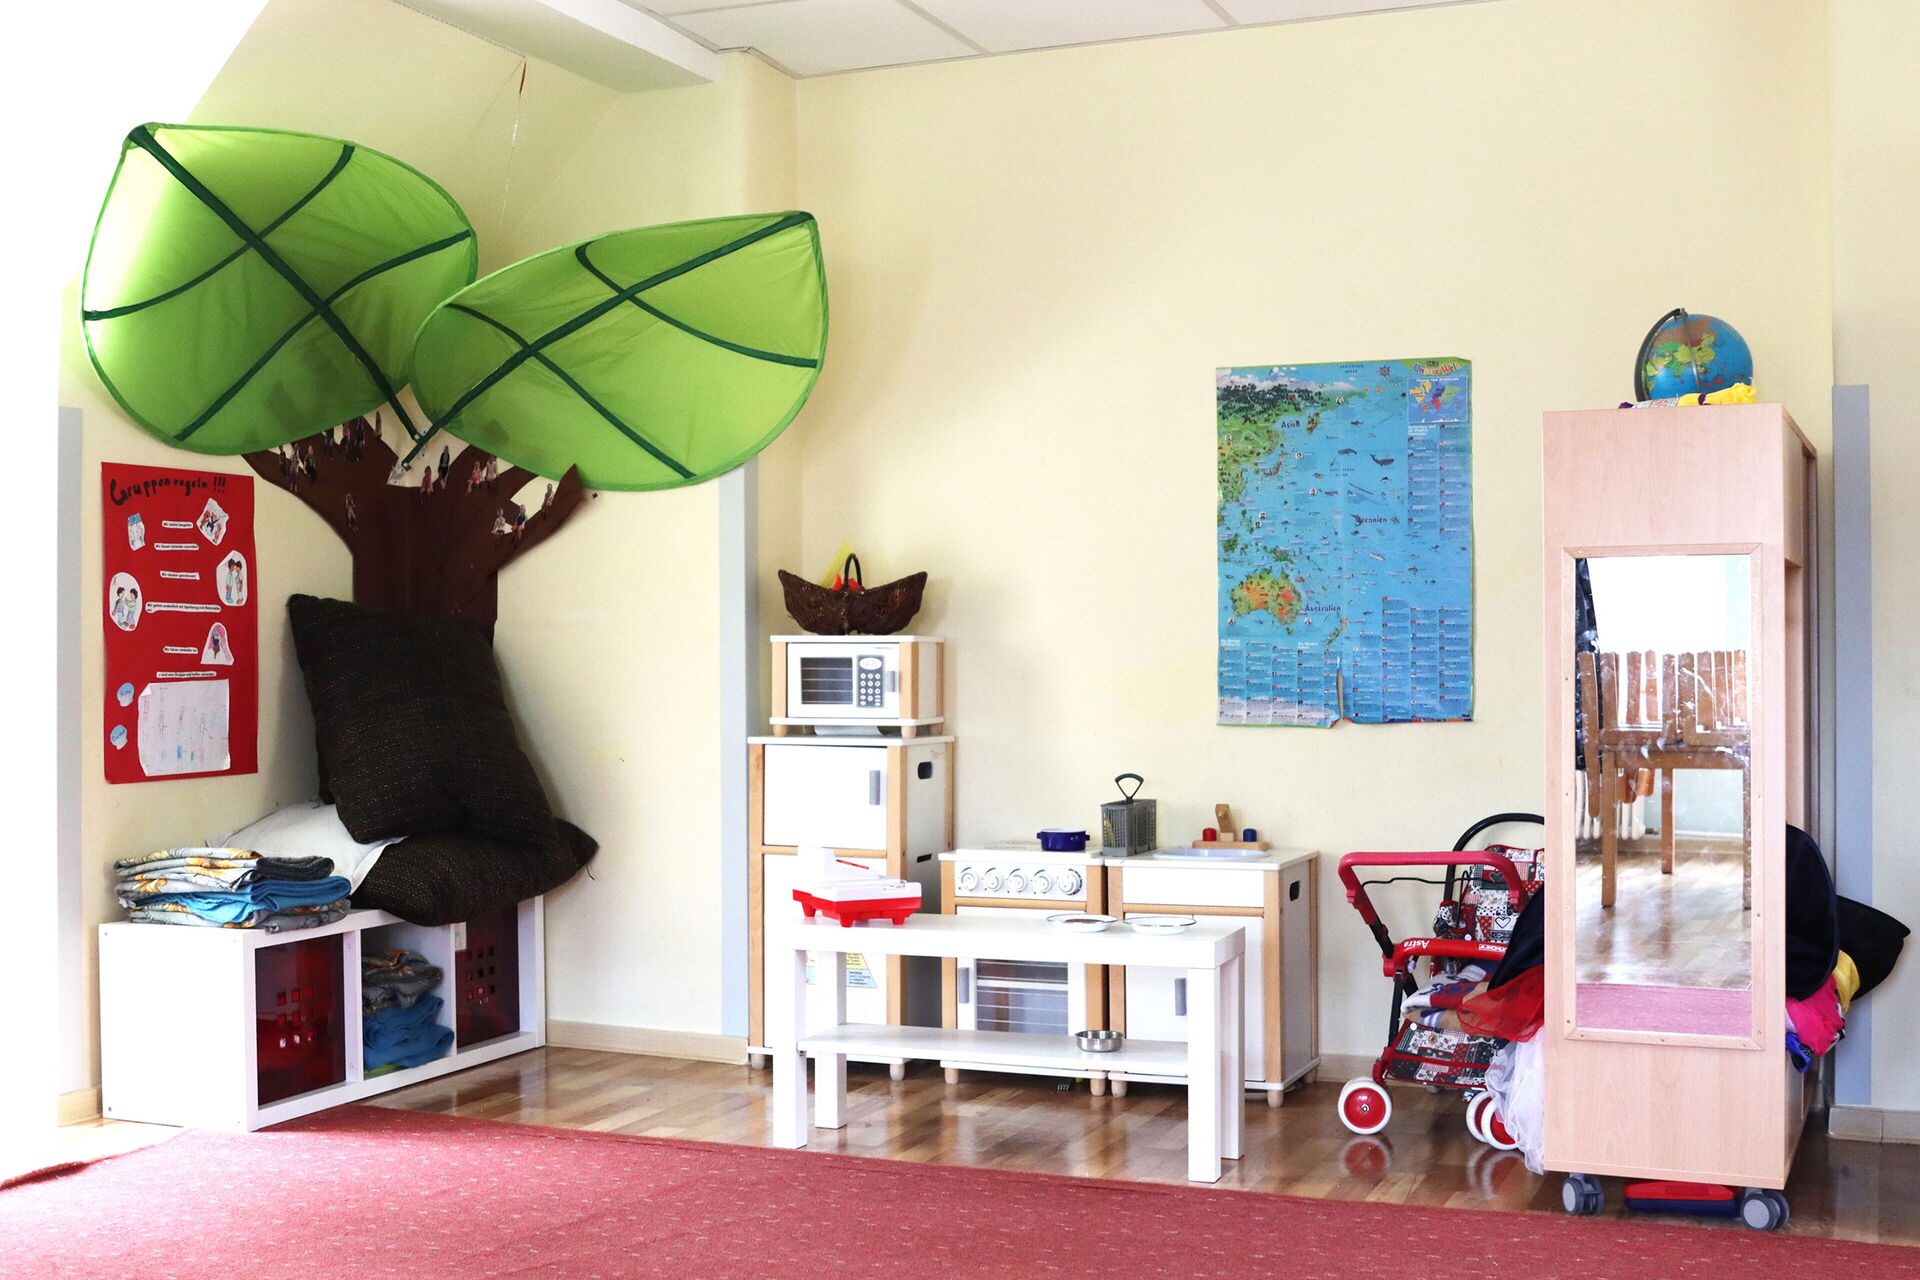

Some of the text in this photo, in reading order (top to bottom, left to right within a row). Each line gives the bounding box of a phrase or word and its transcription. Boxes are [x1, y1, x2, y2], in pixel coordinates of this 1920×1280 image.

[1281, 421, 1300, 429] Asien
[1305, 604, 1341, 613] Australien
[1403, 940, 1430, 949] Astra
